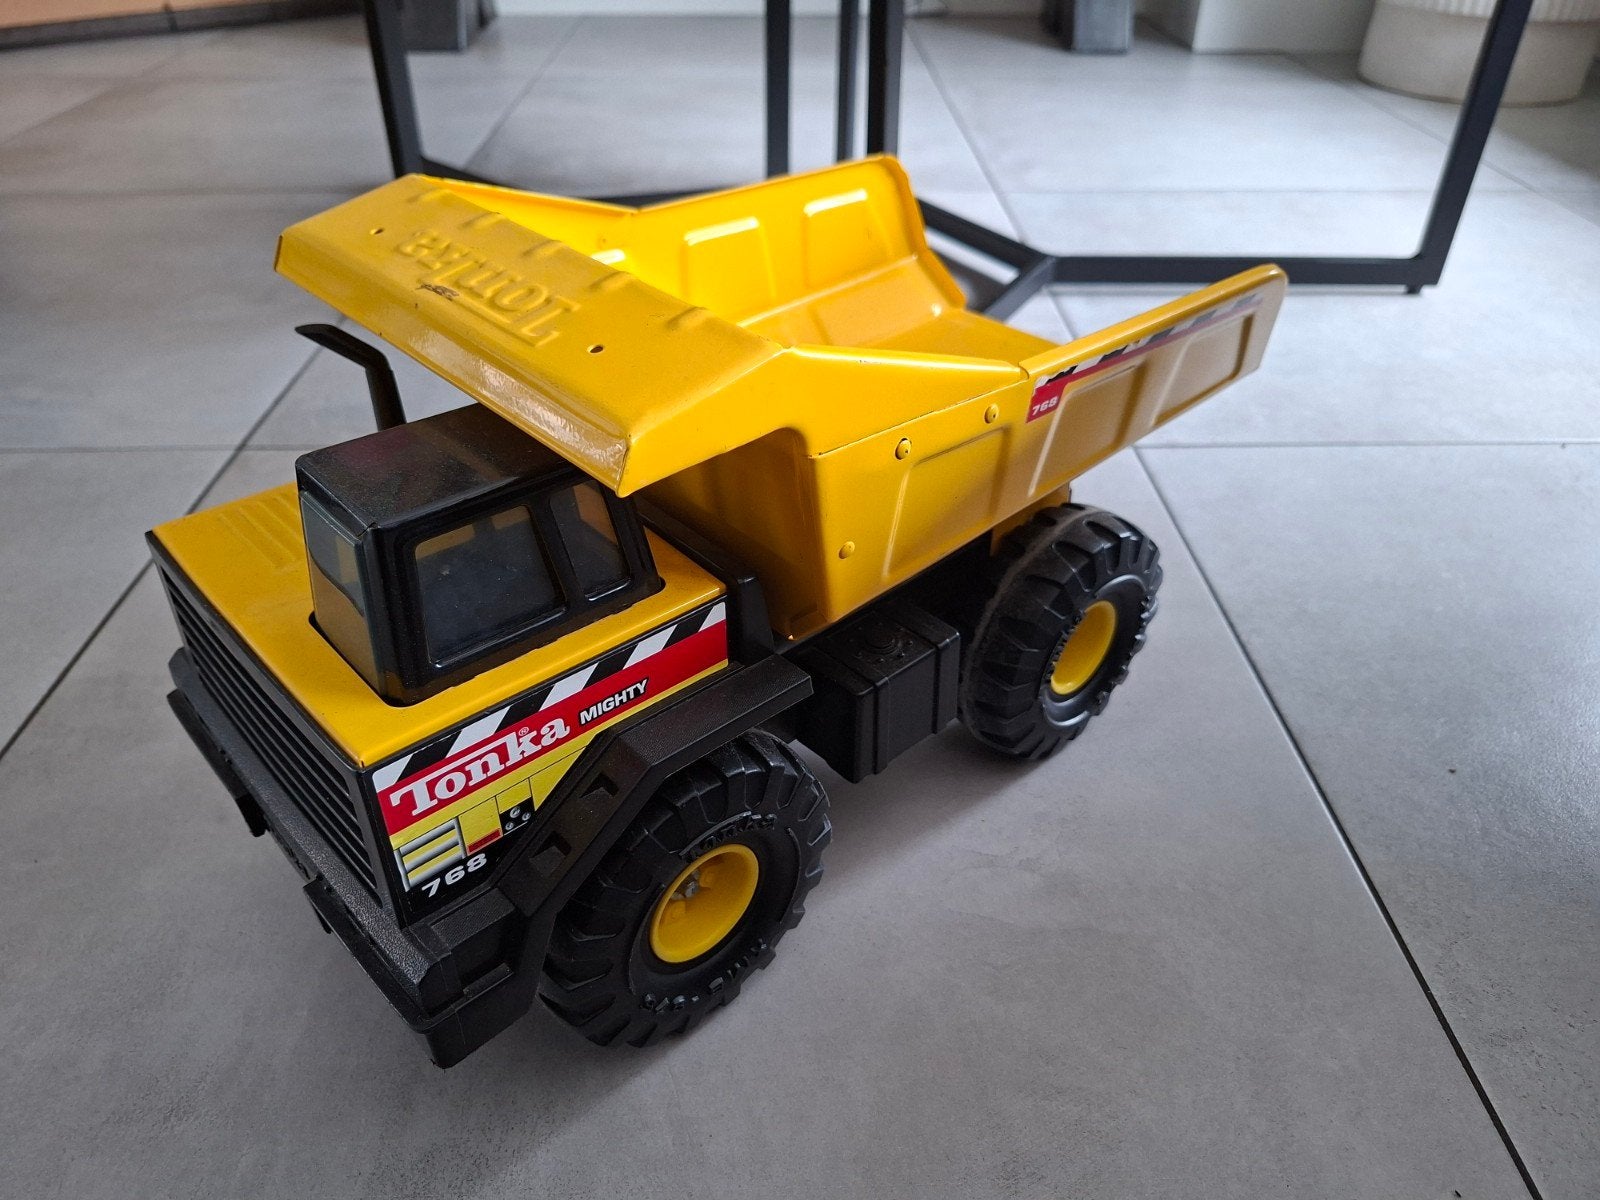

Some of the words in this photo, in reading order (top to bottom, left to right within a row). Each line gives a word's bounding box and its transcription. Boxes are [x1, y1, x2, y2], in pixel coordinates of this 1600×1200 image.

[397, 230, 581, 347] Tonka
[1032, 396, 1059, 416] 768
[579, 679, 648, 725] MIGHTY
[421, 853, 487, 898] 768
